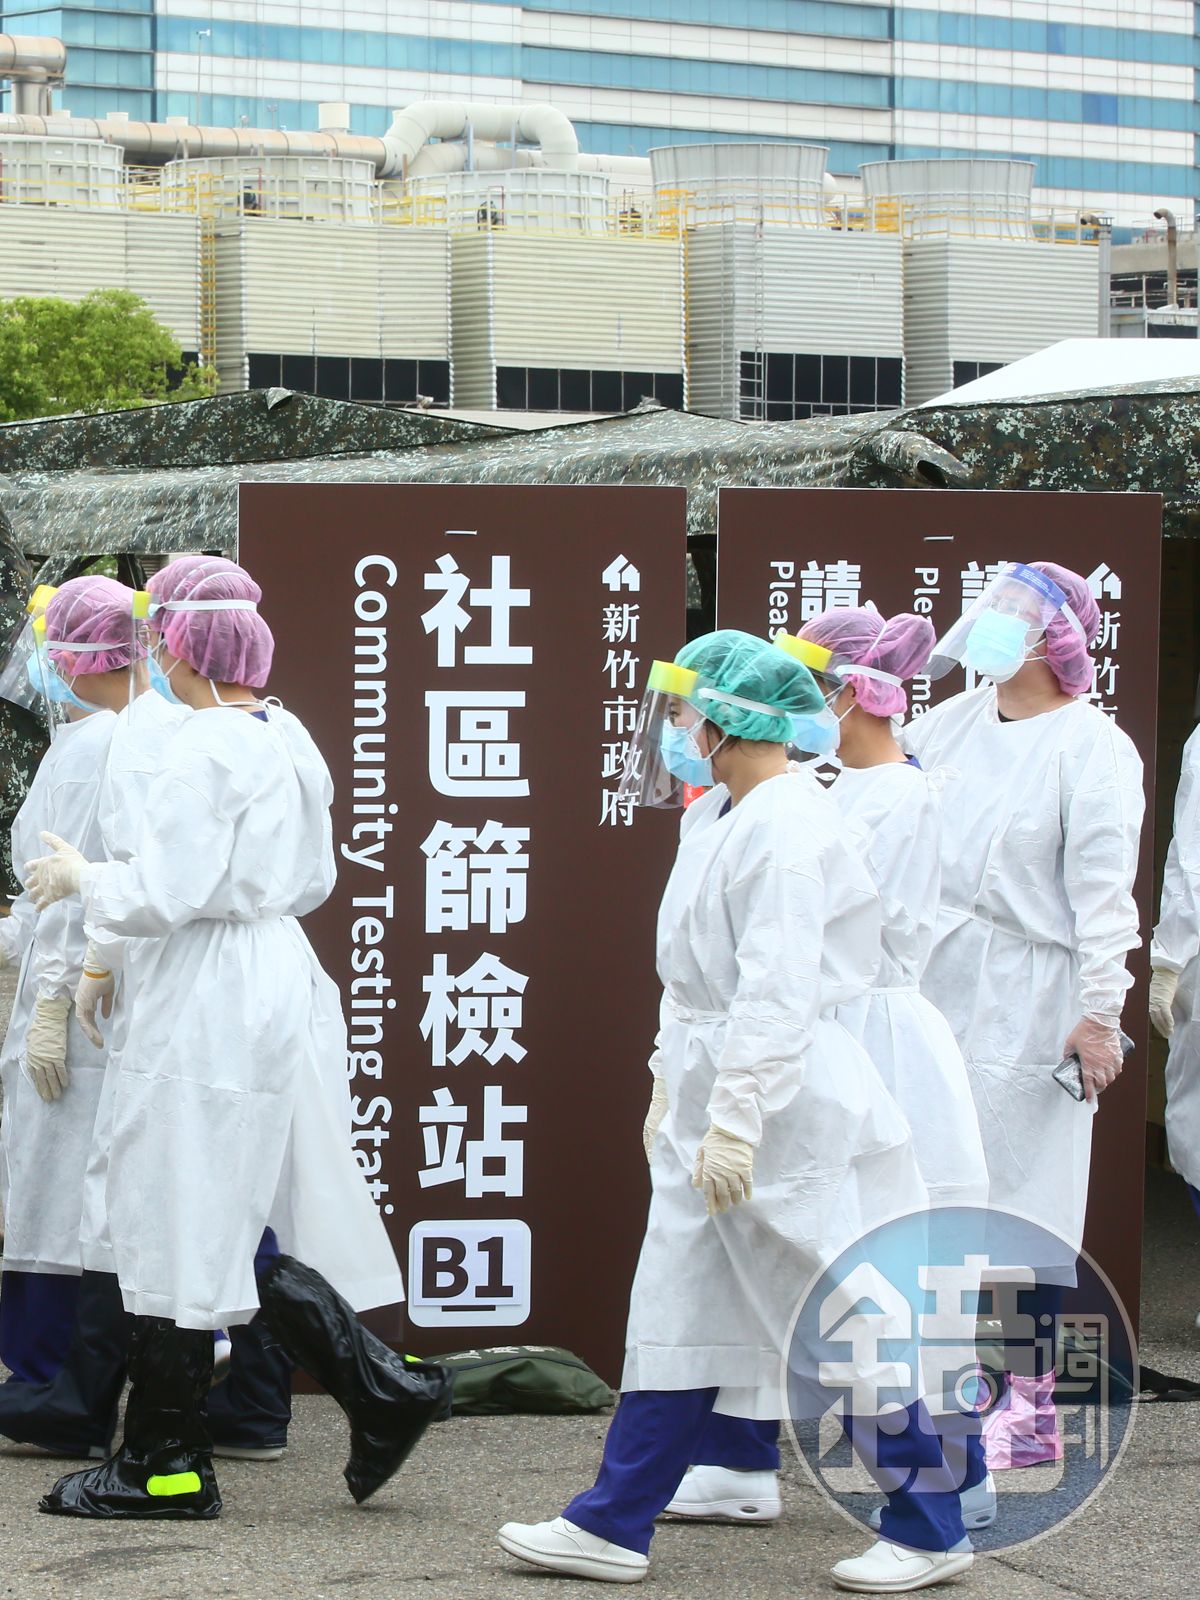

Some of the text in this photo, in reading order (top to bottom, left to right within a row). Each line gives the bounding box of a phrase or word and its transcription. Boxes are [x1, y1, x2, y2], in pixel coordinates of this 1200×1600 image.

[768, 560, 796, 642] Pleas
[598, 603, 643, 828] 新竹市政府
[340, 554, 399, 1215] Community Testing Stat
[418, 552, 534, 1199] 社區篩檢站
[421, 1236, 514, 1299] B1
